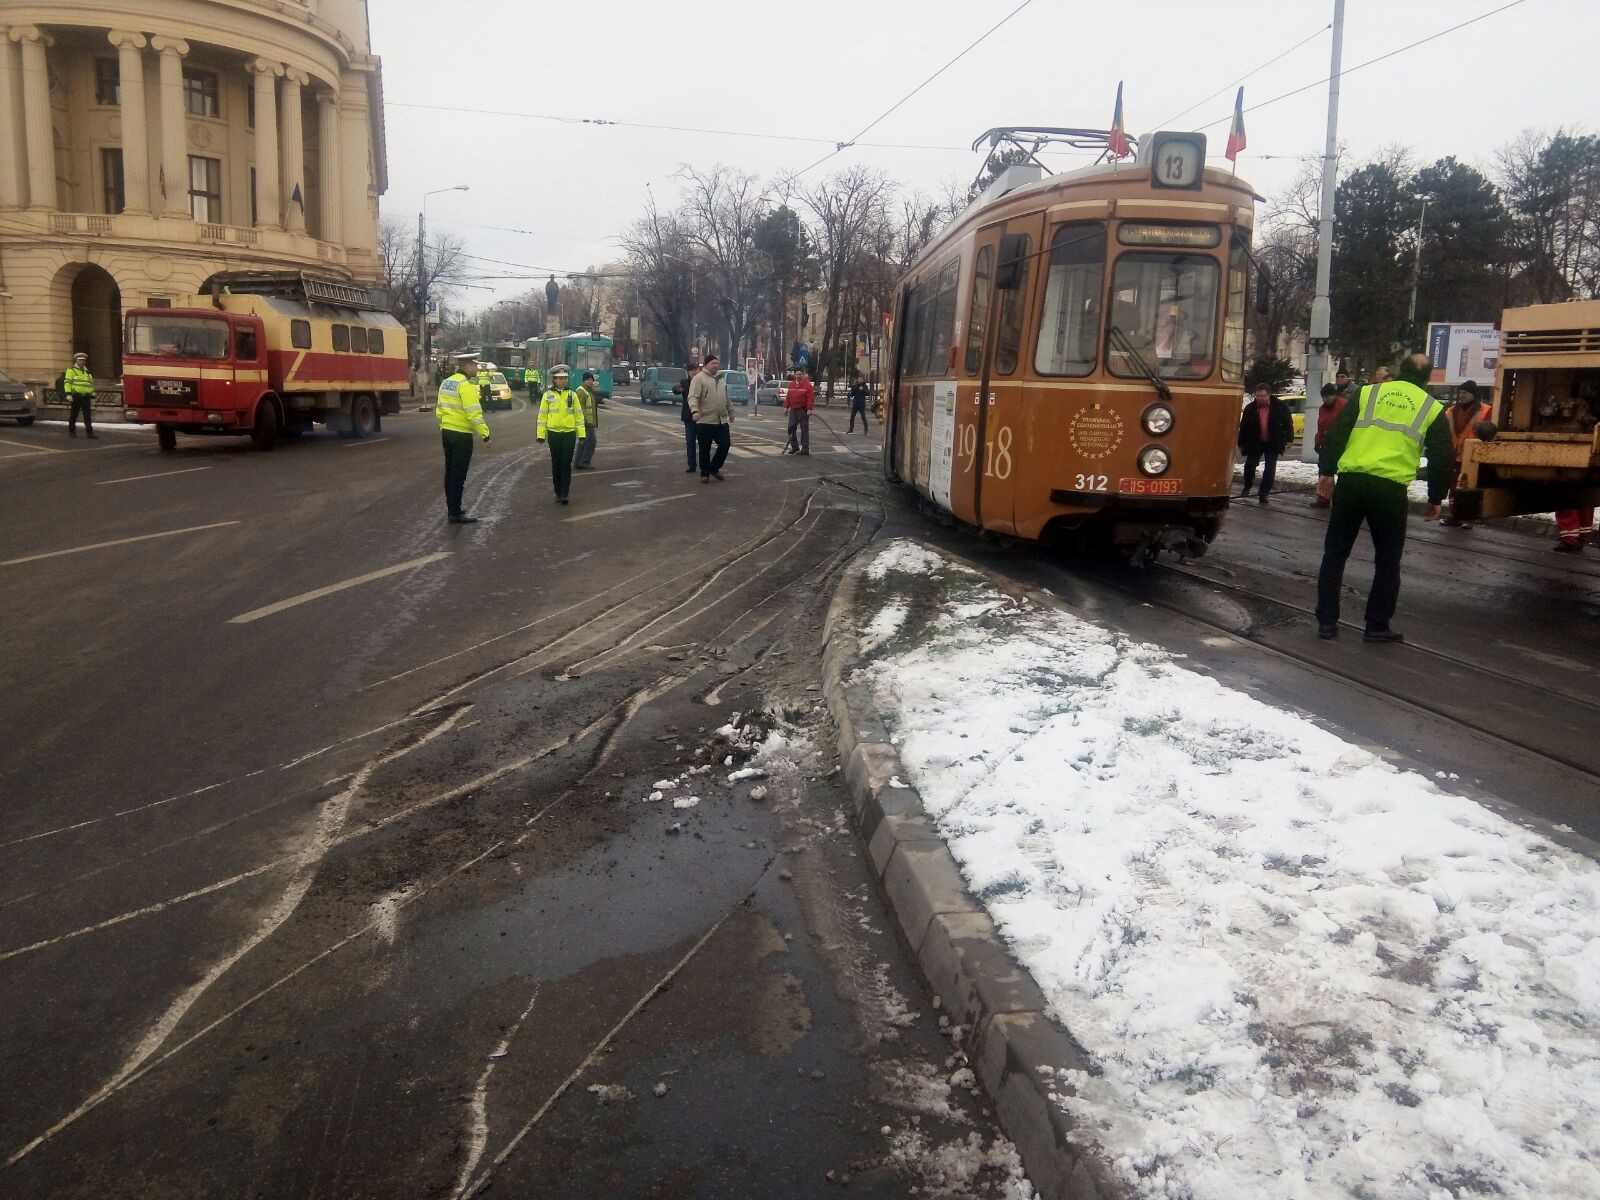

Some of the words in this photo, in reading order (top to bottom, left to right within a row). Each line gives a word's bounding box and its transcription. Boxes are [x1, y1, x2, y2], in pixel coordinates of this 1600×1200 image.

[1165, 155, 1184, 180] 13
[1377, 391, 1403, 405] CONTROL
[1404, 394, 1416, 412] TRAFIC
[1074, 473, 1108, 491] 312
